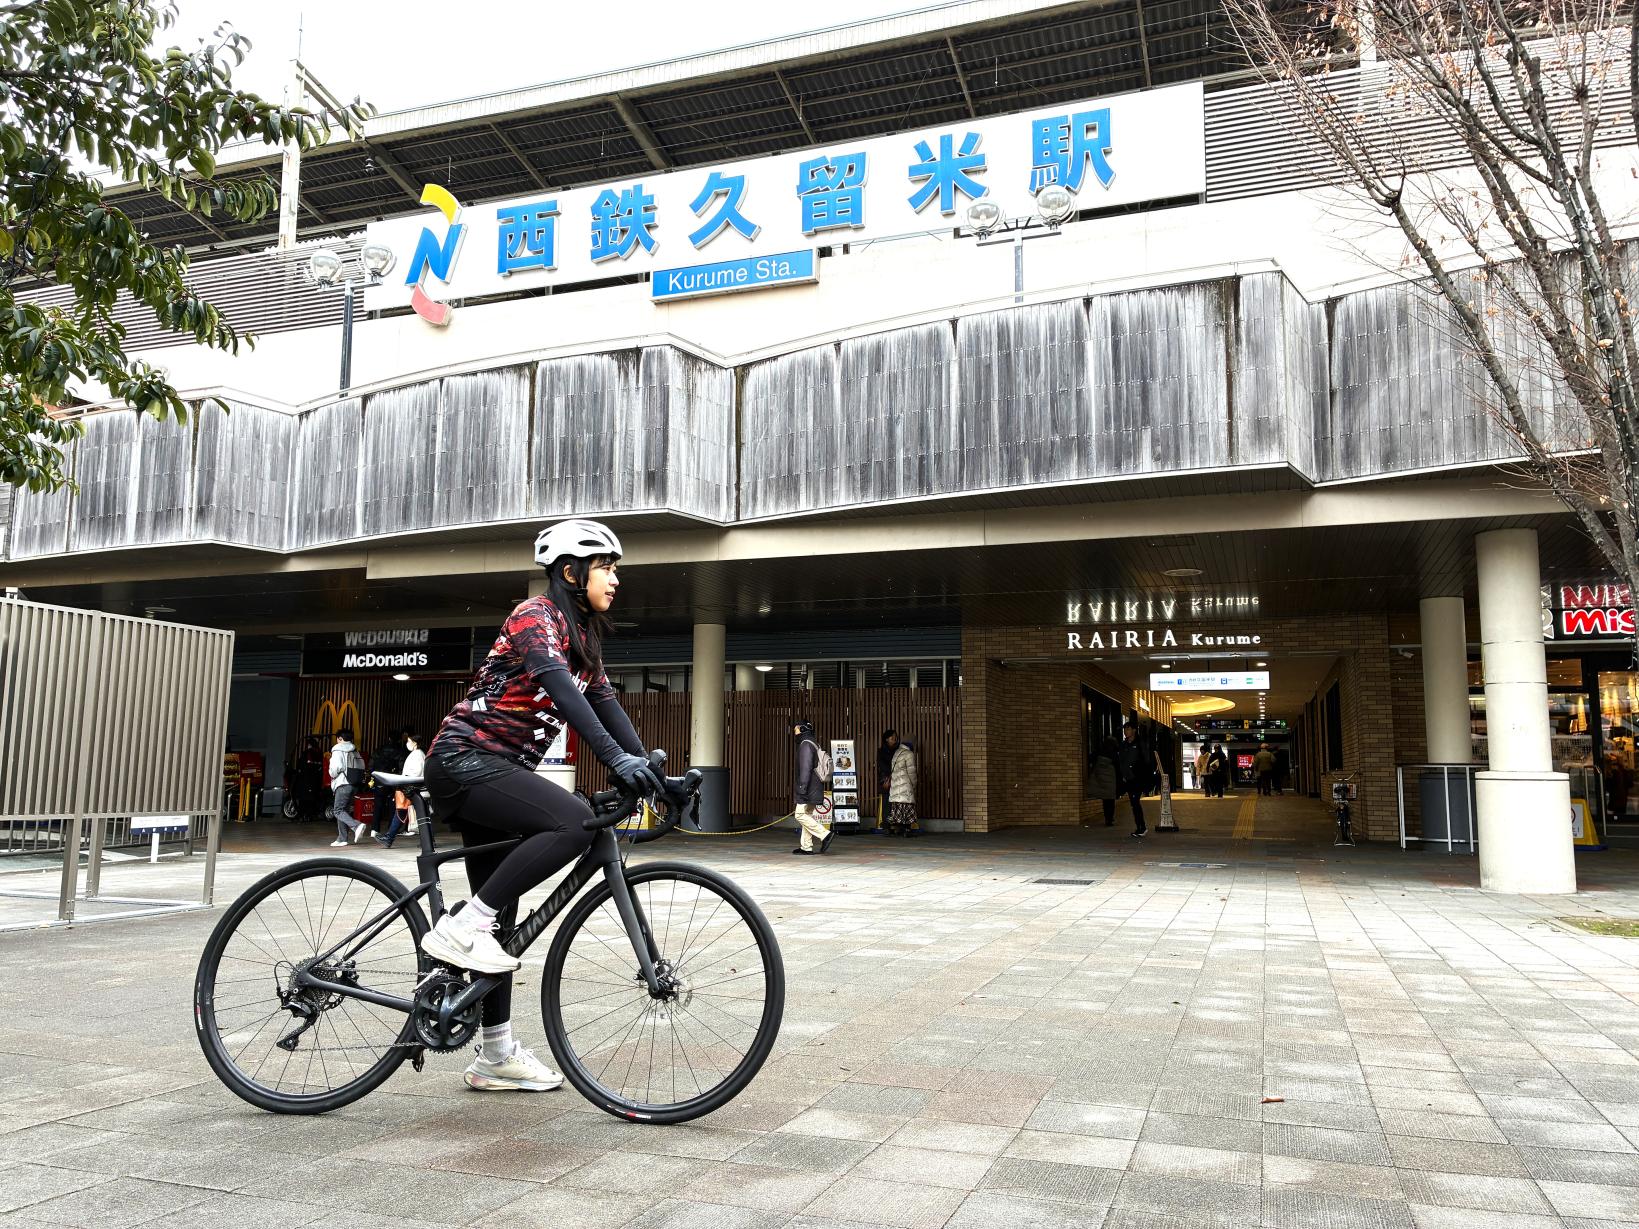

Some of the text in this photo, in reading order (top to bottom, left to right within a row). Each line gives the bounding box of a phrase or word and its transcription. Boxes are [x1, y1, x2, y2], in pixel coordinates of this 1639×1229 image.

[497, 107, 1117, 276] 西鉄久留米駅
[667, 261, 797, 292] Kurume Sta.
[1067, 629, 1261, 650] RAIRIA Kurume
[342, 651, 428, 668] McDonald's
